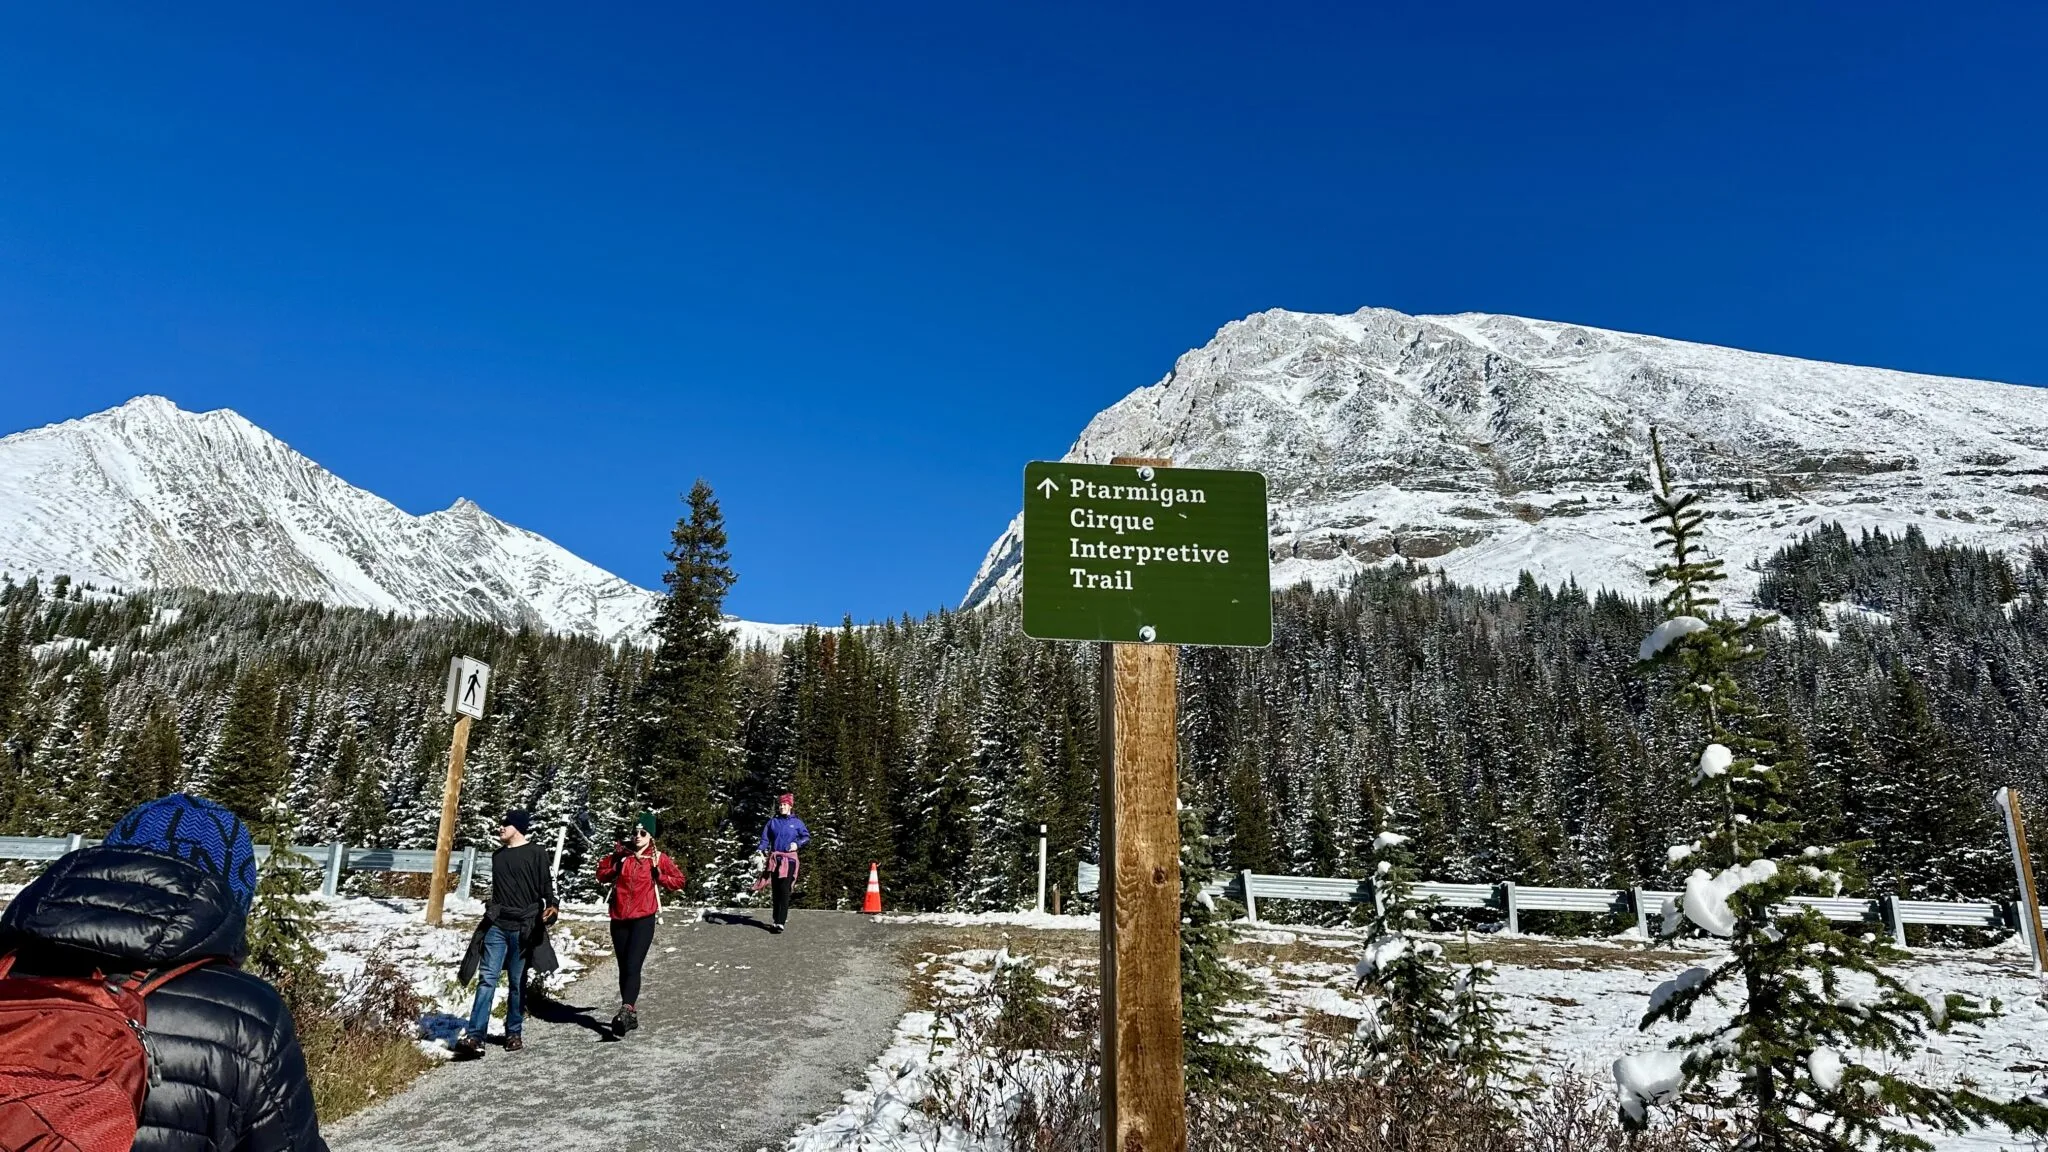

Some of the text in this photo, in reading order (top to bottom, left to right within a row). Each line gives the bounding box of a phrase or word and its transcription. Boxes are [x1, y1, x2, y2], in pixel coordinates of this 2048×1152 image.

[1070, 478, 1206, 508] Ptarmigan
[1070, 508, 1154, 534] Cirque
[1069, 537, 1229, 566] Interpretive
[1069, 567, 1134, 590] Trail
